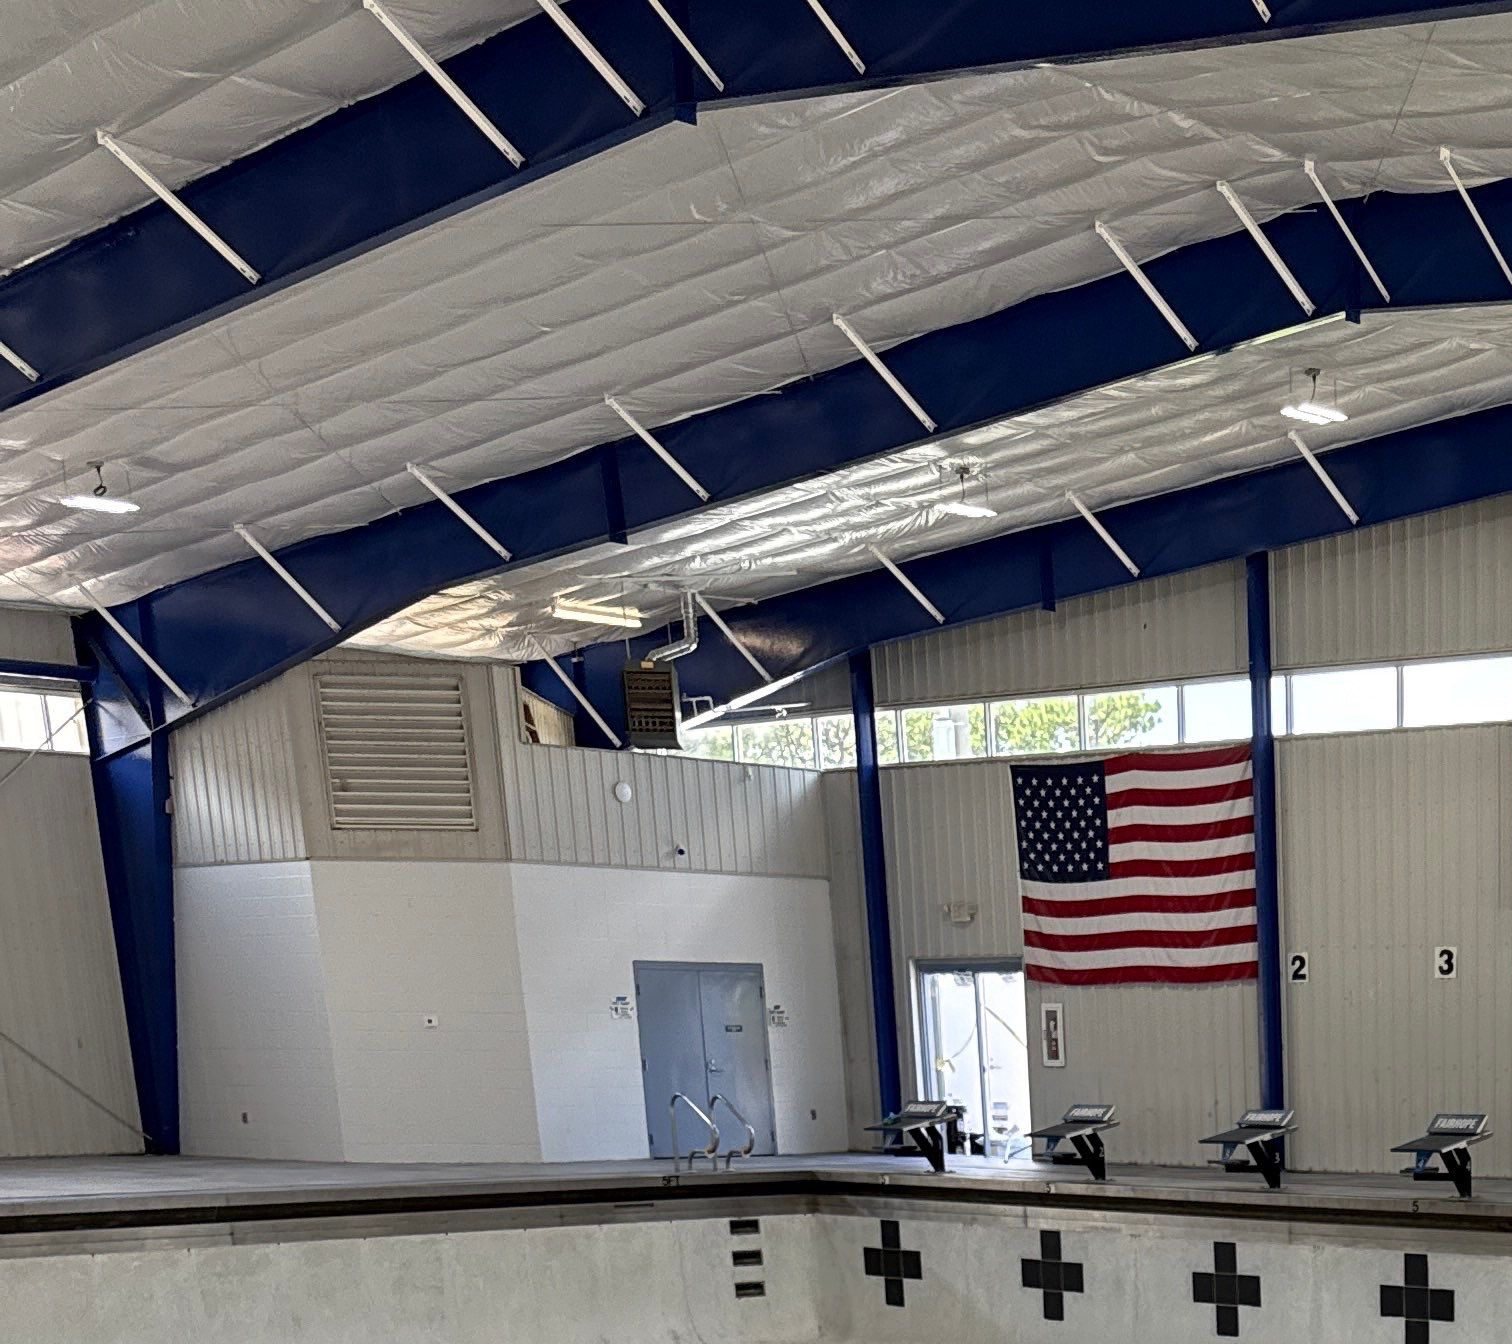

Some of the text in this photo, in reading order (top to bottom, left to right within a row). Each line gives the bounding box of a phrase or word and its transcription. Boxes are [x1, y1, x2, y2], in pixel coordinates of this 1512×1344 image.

[1291, 955, 1307, 981] 2
[1438, 949, 1454, 976] 3
[1434, 1118, 1479, 1129] FAIRHOPE
[1412, 1201, 1419, 1213] 5
